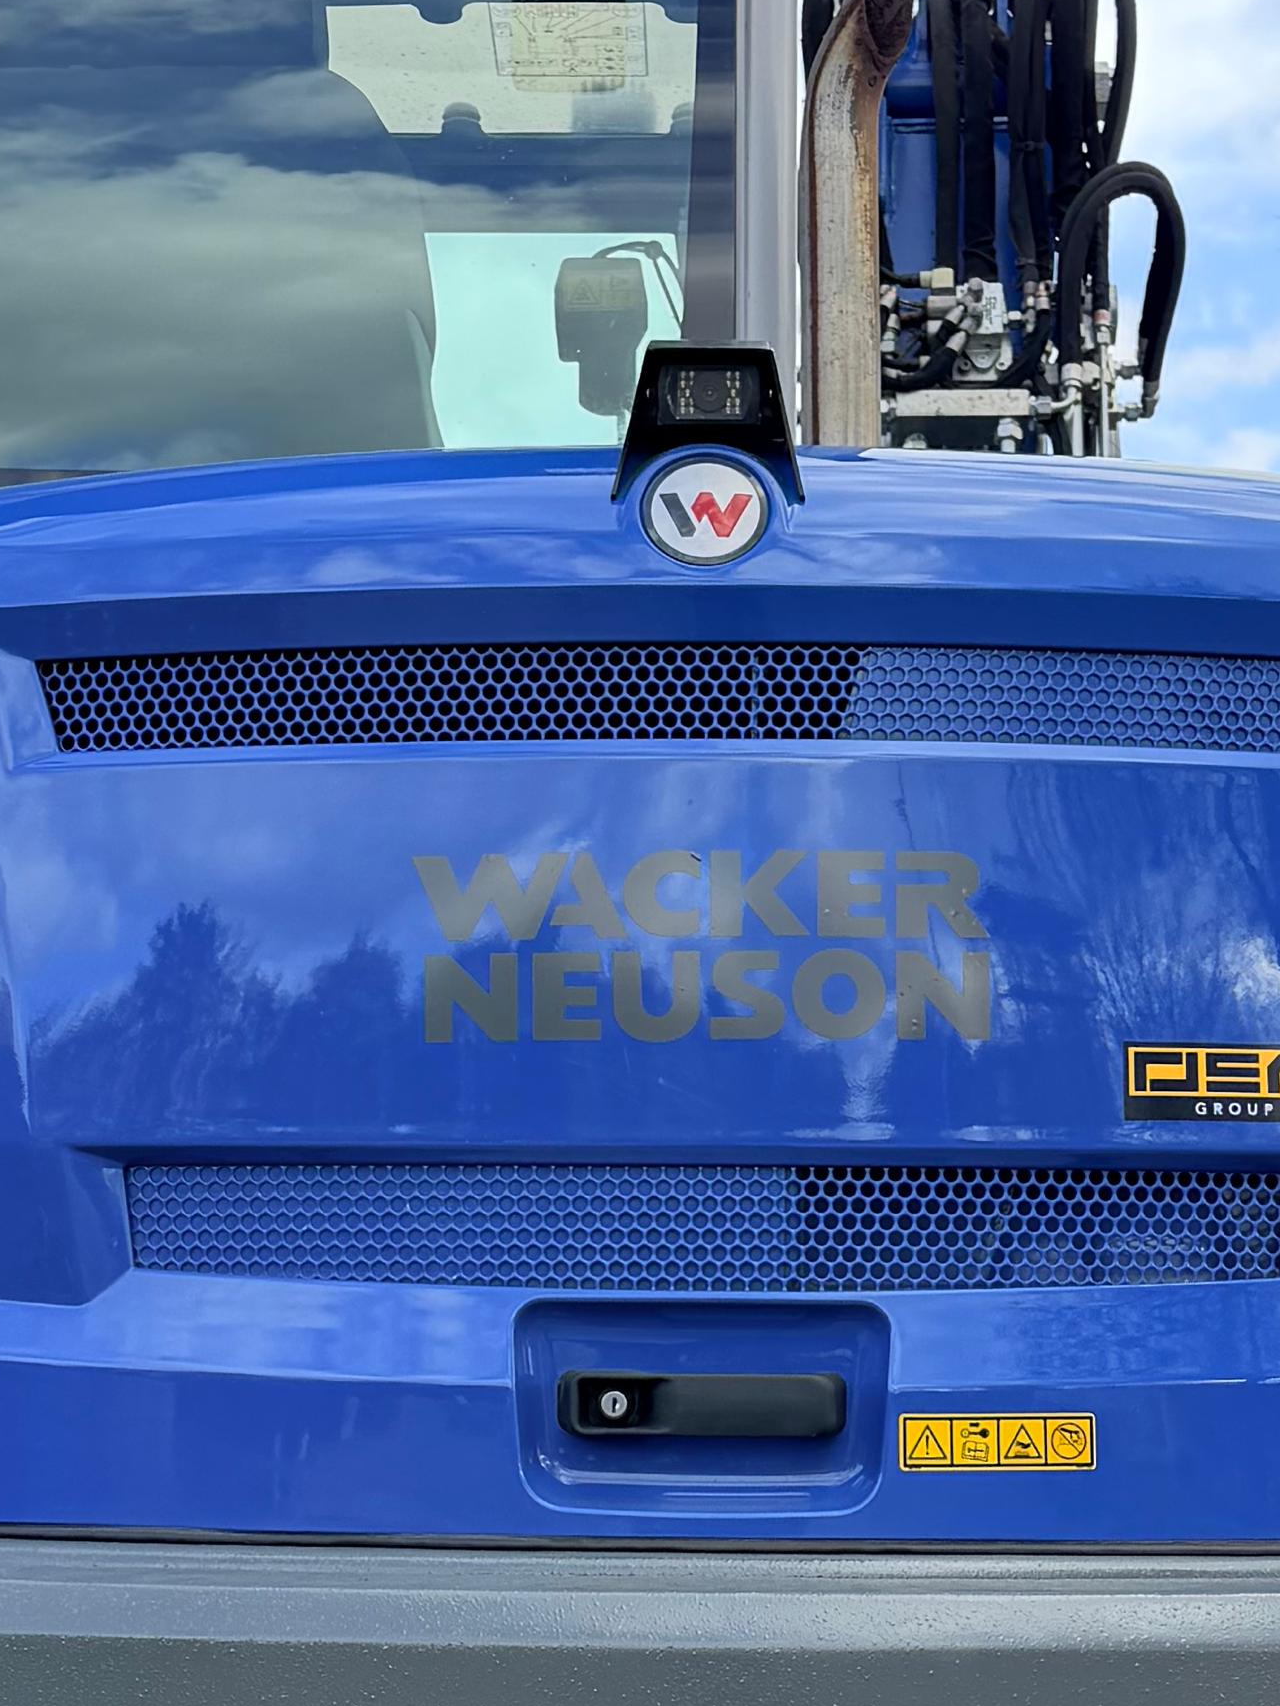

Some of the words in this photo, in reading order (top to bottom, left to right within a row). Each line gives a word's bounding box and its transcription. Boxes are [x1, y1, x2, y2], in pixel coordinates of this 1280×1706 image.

[412, 849, 989, 941] WACKER
[424, 949, 992, 1043] NEUSON
[1195, 1101, 1274, 1116] GROUP
